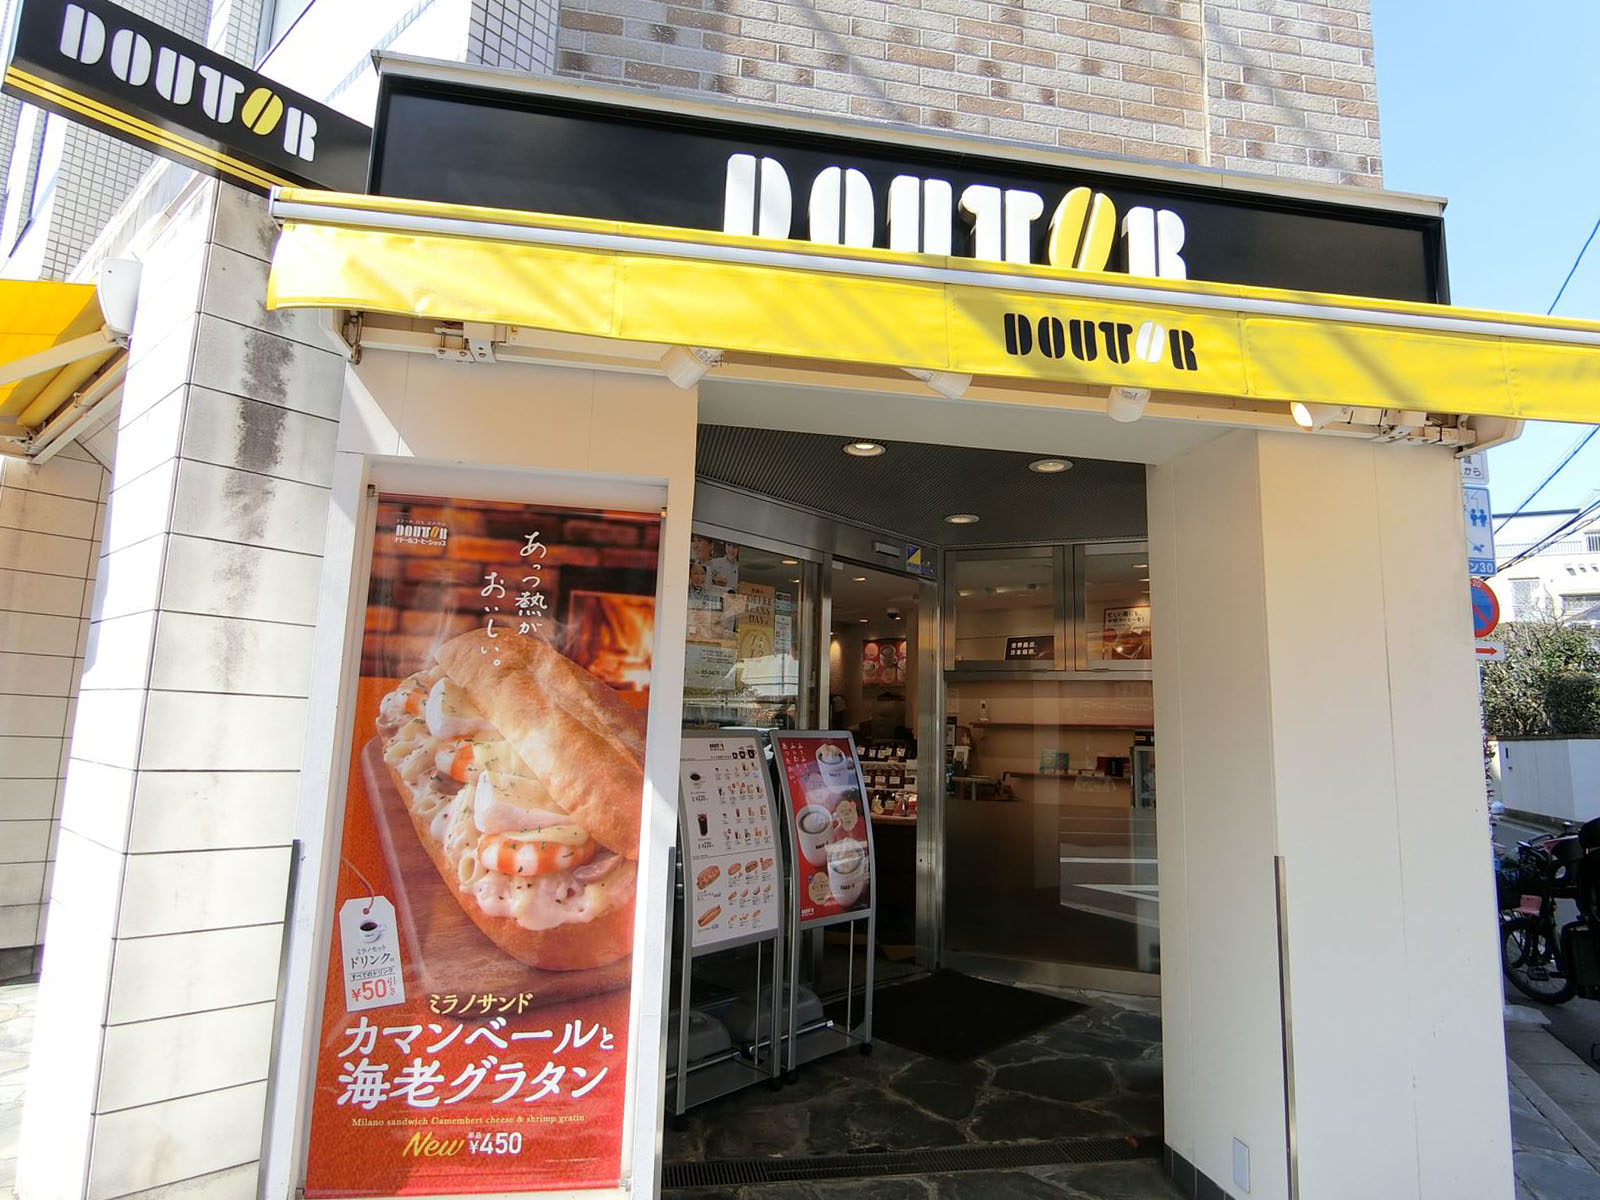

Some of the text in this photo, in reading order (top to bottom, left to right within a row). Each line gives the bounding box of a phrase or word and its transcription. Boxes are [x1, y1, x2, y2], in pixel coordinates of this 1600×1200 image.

[59, 3, 318, 162] DOUTOR
[722, 153, 1187, 280] DOUTOR
[1004, 312, 1198, 371] DOUTOR
[395, 524, 448, 540] DOUTOR
[515, 531, 548, 635] あっつ熱が
[481, 571, 506, 666] おいしい。
[351, 952, 390, 969] ドリンク
[352, 979, 387, 1001] ¥50
[429, 993, 533, 1014] ミラノサンド
[337, 1016, 615, 1058] カマンベールと
[336, 1055, 609, 1110] 海老グラタン
[352, 1118, 384, 1127] Milano
[387, 1117, 429, 1126] sandwich
[431, 1116, 483, 1125] Camembert
[485, 1115, 514, 1124] cheese
[527, 1114, 556, 1124] shrimp
[559, 1114, 585, 1124] gratin
[402, 1131, 465, 1157] New
[469, 1131, 522, 1155] ¥450
